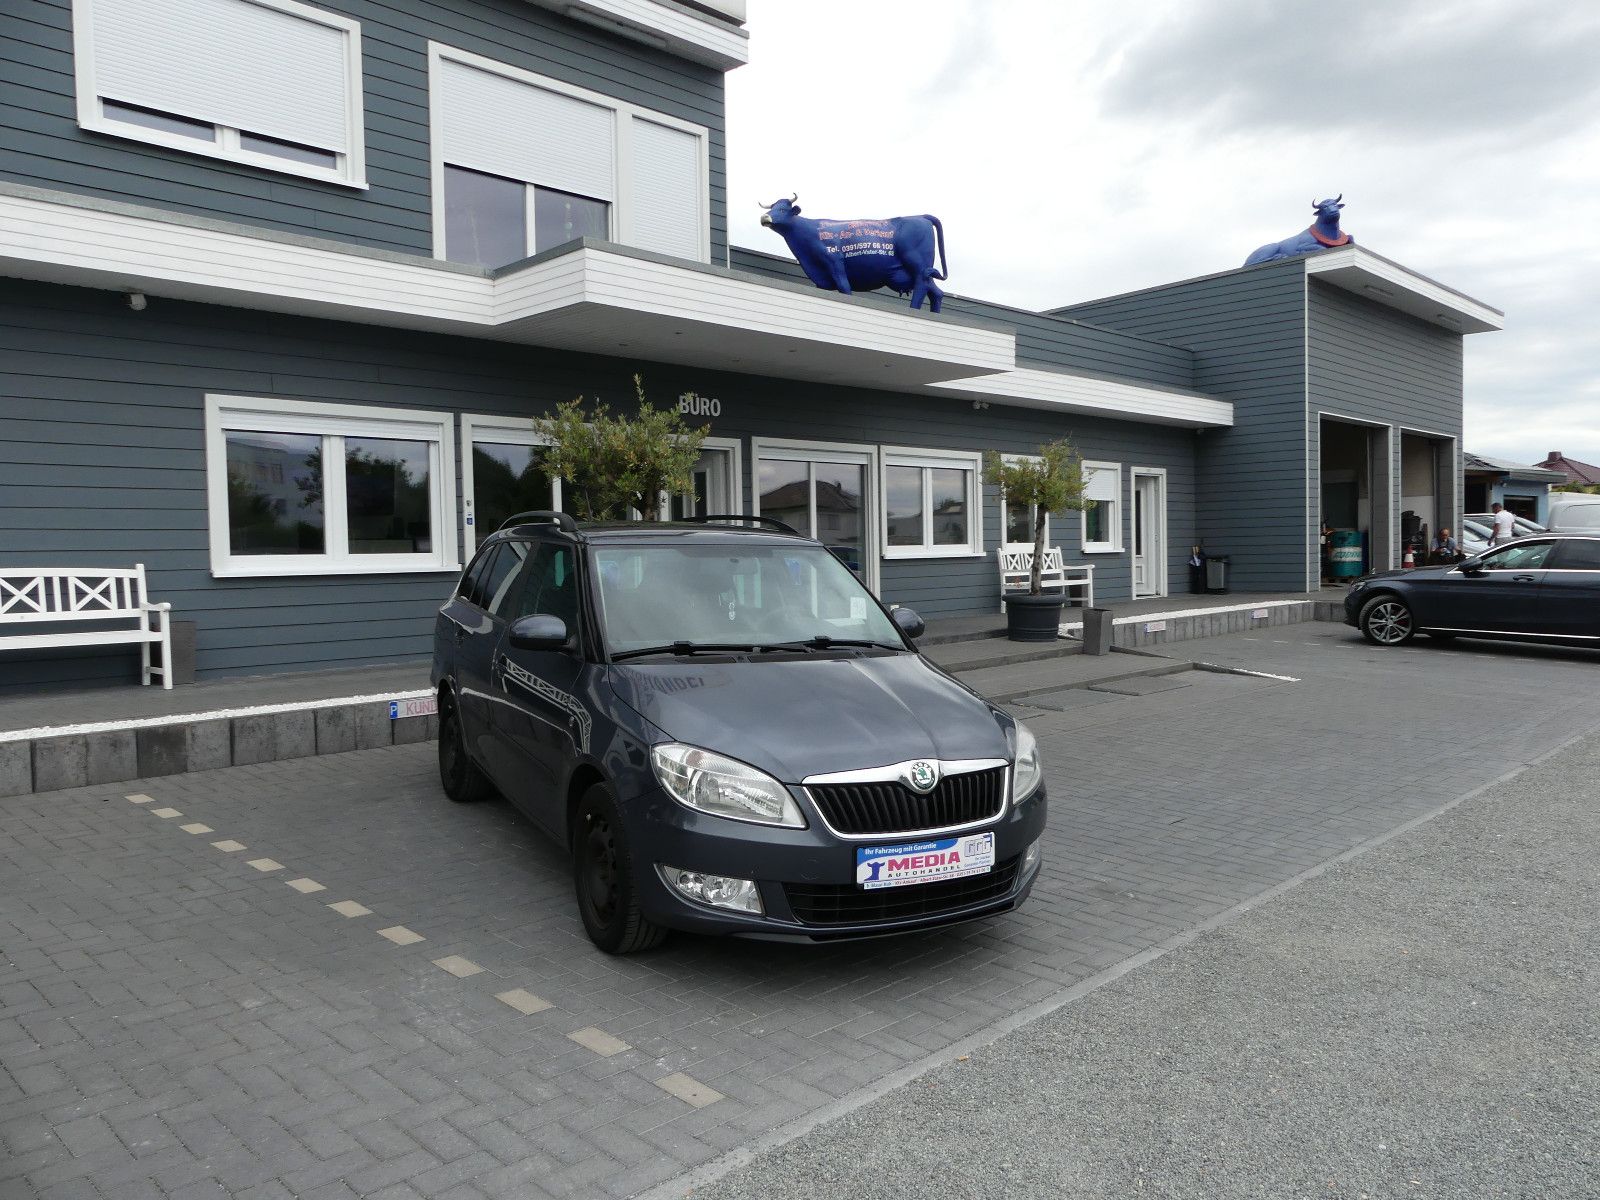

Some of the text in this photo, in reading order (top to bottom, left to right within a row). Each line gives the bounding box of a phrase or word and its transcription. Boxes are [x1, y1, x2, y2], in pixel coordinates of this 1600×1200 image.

[841, 242, 872, 253] 0391/597
[679, 393, 721, 417] BÜRO
[390, 705, 398, 716] P
[874, 846, 903, 855] Fahrzeug
[913, 842, 937, 851] Garantie
[887, 851, 961, 871] MEDIA
[887, 865, 961, 878] AUTOHANDEL
